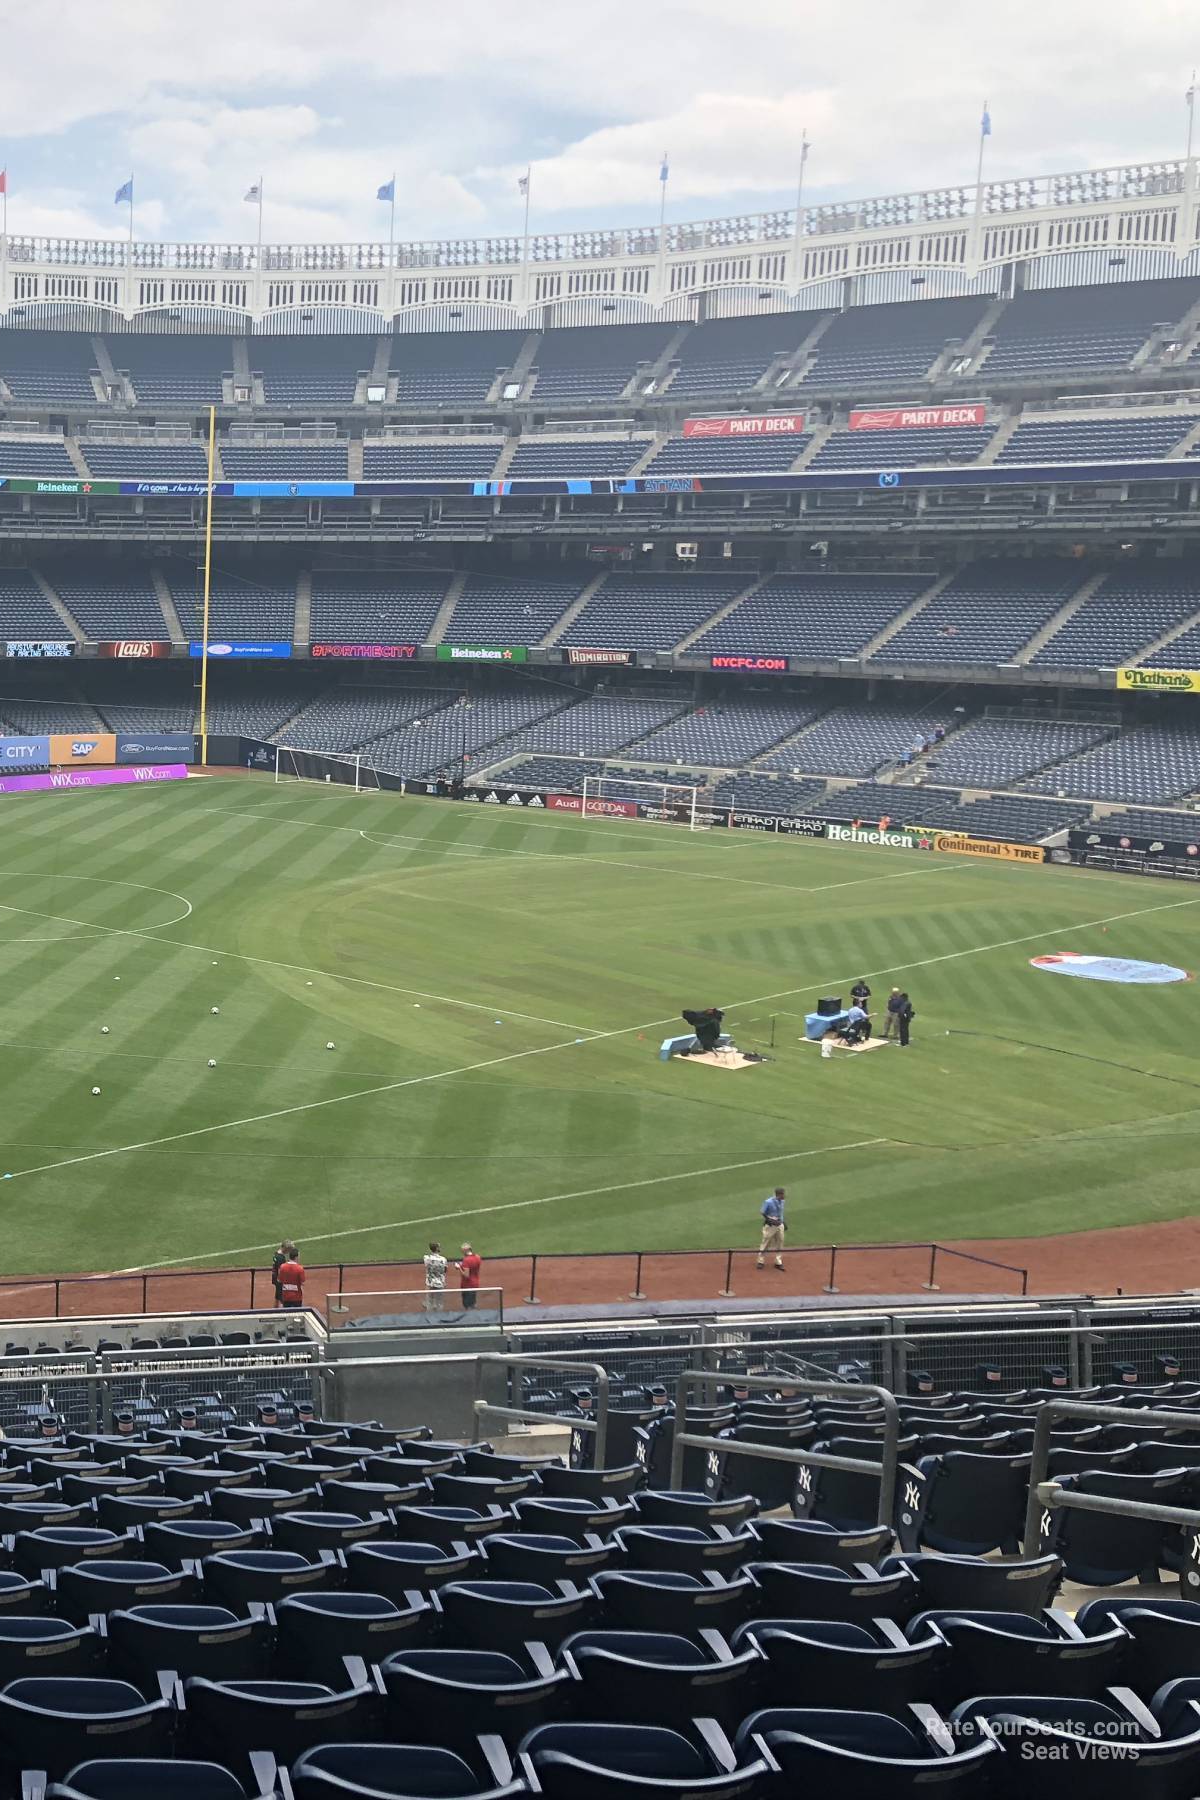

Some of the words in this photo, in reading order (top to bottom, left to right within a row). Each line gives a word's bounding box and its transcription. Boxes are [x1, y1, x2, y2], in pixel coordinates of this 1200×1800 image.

[901, 413, 940, 425] PARTY
[942, 410, 977, 423] DECK
[729, 420, 763, 433] PARTY
[765, 418, 795, 431] DECK
[37, 482, 79, 492] Heineken
[6, 643, 36, 651] ABUSIVE
[39, 643, 69, 651] LANGUAGE
[117, 641, 150, 658] Lay's
[312, 645, 416, 658] #FORTHECITY
[450, 648, 502, 659] Heineken
[572, 651, 628, 663] ADMIRATION
[712, 657, 785, 669] NYCFC.COM
[1124, 669, 1192, 686] Nathan's
[71, 742, 94, 755] SAP
[555, 798, 580, 809] Audi
[733, 815, 774, 826] ETIHAD
[780, 820, 823, 832] ETIHAD
[827, 824, 913, 849] Heineken
[937, 837, 1002, 855] Continental
[1013, 849, 1040, 860] TIRE
